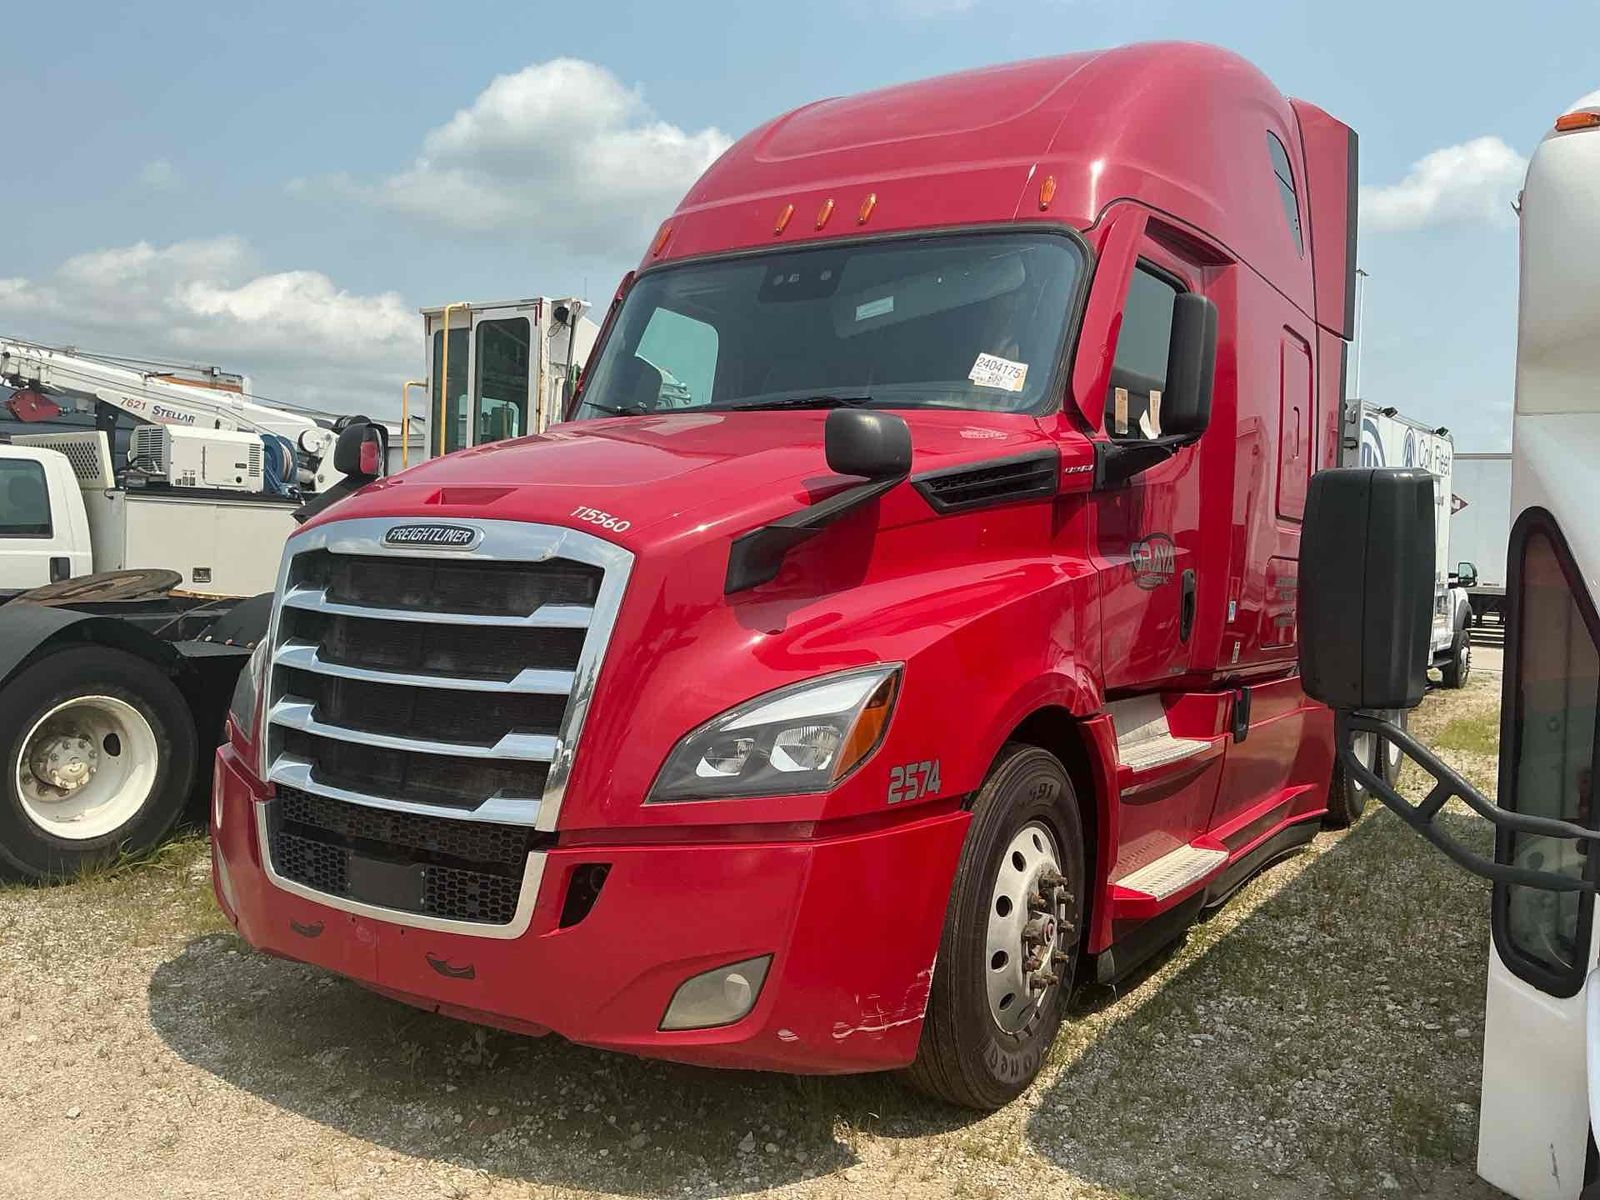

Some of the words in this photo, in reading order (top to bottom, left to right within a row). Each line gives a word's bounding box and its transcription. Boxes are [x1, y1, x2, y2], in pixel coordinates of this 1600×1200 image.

[976, 357, 1022, 379] 2404175
[120, 396, 147, 411] 7621
[152, 405, 196, 424] STELLAR
[388, 526, 472, 544] FREIGHTLINER
[887, 759, 942, 805] 2574
